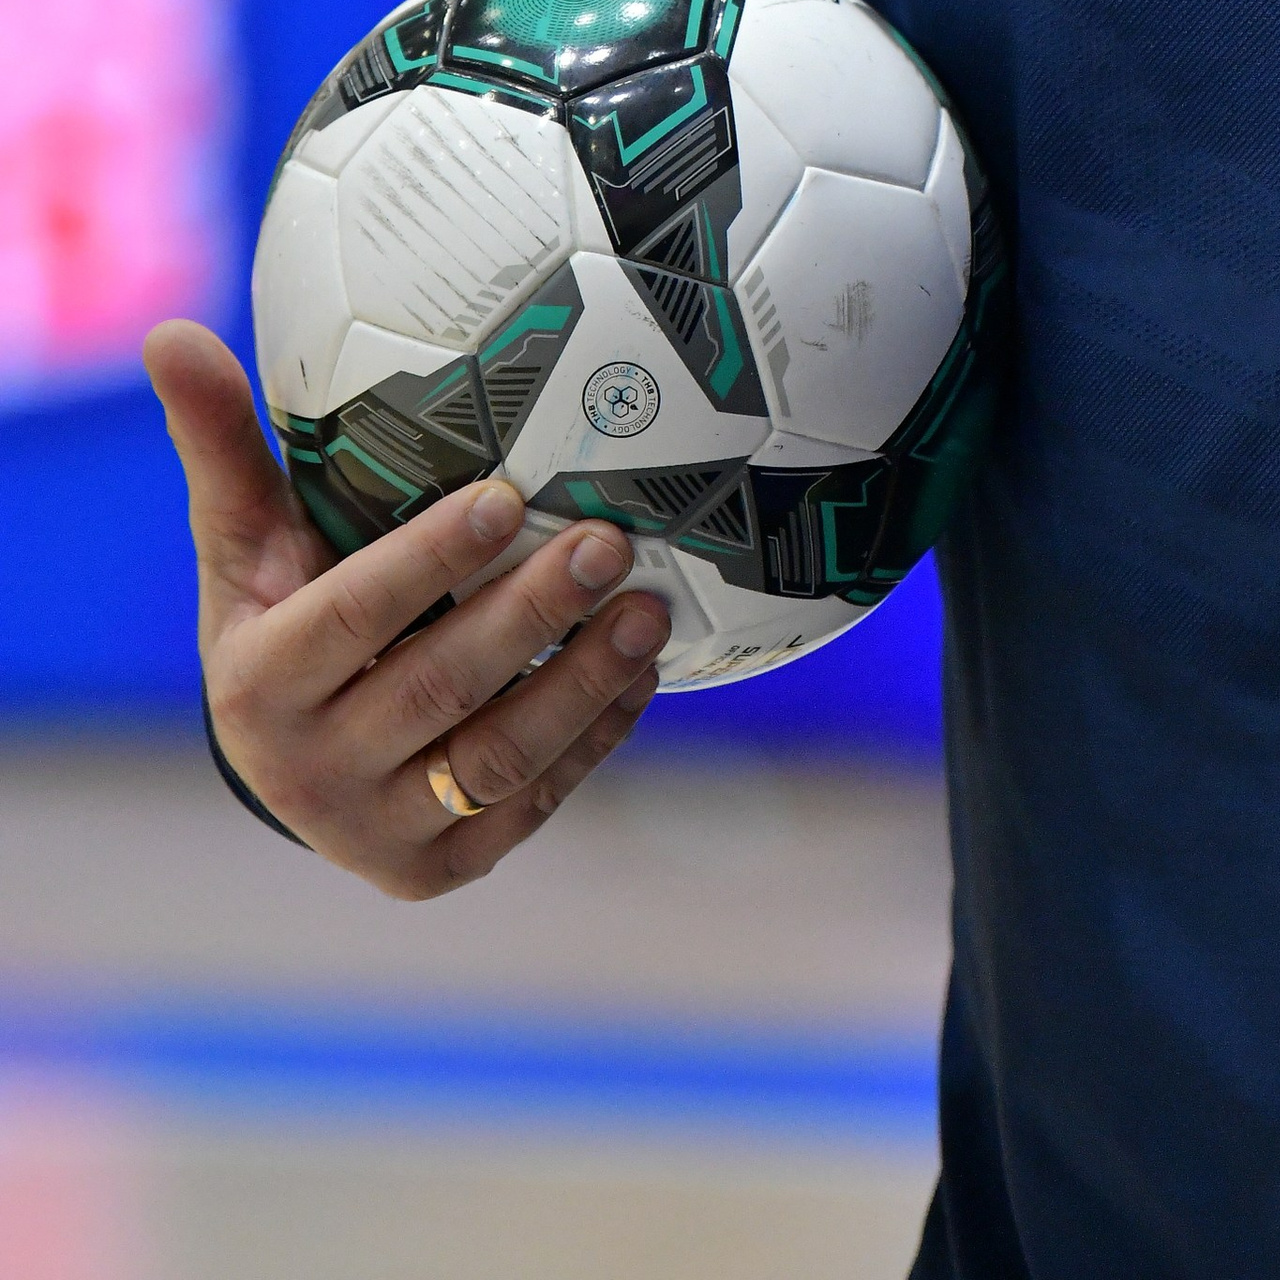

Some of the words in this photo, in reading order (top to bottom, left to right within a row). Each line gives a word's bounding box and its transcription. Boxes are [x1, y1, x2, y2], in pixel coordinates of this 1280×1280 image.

[586, 366, 632, 402] TECHNOLOGY
[641, 376, 655, 395] THB
[588, 404, 601, 424] THB
[611, 397, 656, 434] TECHNOLOGY
